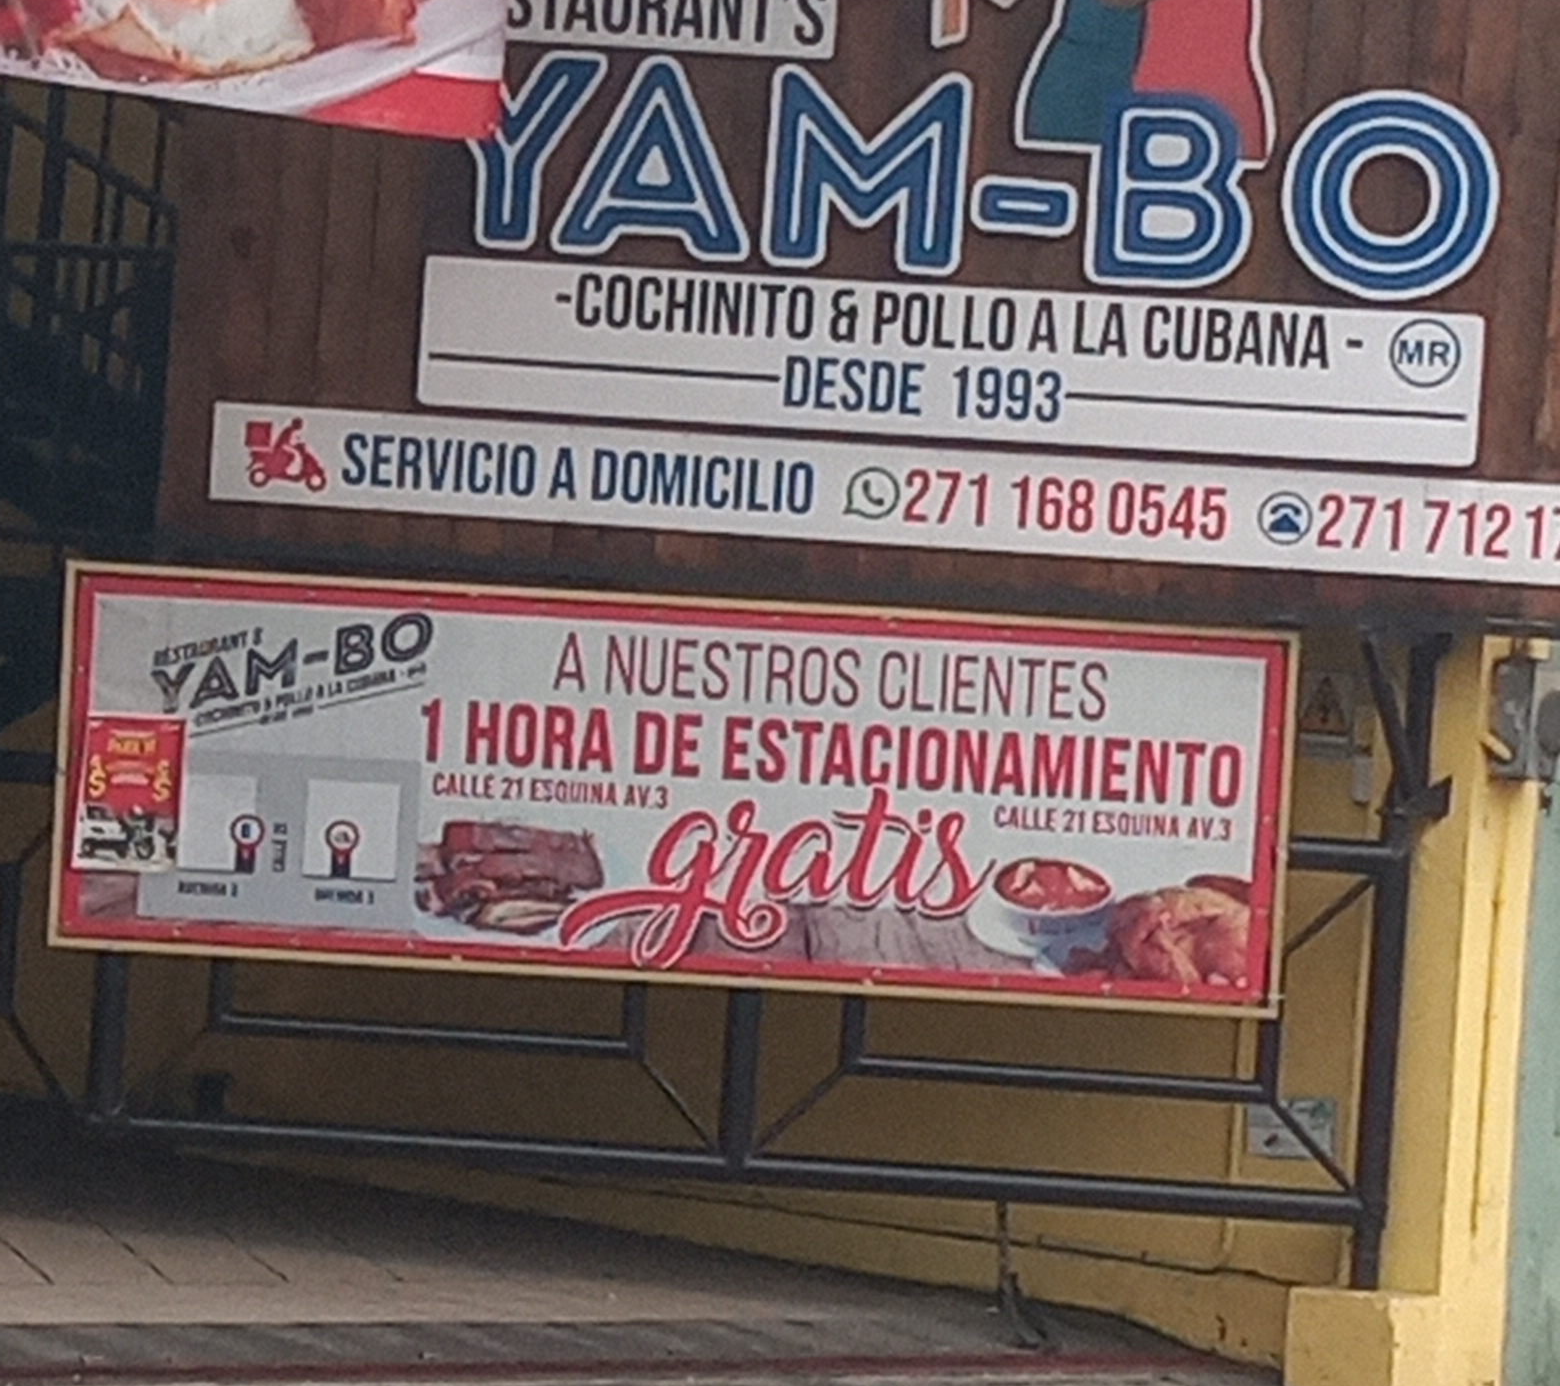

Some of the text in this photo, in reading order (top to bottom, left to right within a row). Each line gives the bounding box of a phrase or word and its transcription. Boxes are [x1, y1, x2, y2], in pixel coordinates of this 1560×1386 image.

[470, 53, 1498, 300] YAM-BO
[829, 290, 857, 343] &
[872, 292, 1016, 352] POLLO
[1028, 298, 1057, 353] A
[1073, 300, 1127, 357] LA
[1396, 337, 1451, 367] MR
[783, 356, 1062, 422] DESDE 1993
[342, 433, 814, 514] SERVICIO A DOMICILIO
[903, 469, 1227, 541] 271 168 0545
[1316, 494, 1560, 561] 271 712 1
[151, 613, 433, 714] YAM-BO
[553, 632, 1108, 722] A NUESTROS CLIENTES
[421, 698, 1241, 808] 1 HORA DE ESTACIONAMIENTO
[433, 773, 494, 799] CALLE
[500, 776, 523, 801] 21
[529, 779, 617, 806] ESQUINA
[994, 804, 1057, 833] CALLE
[1062, 809, 1087, 834] 21
[1092, 811, 1180, 839] ESQUINA
[558, 786, 996, 968] gratis
